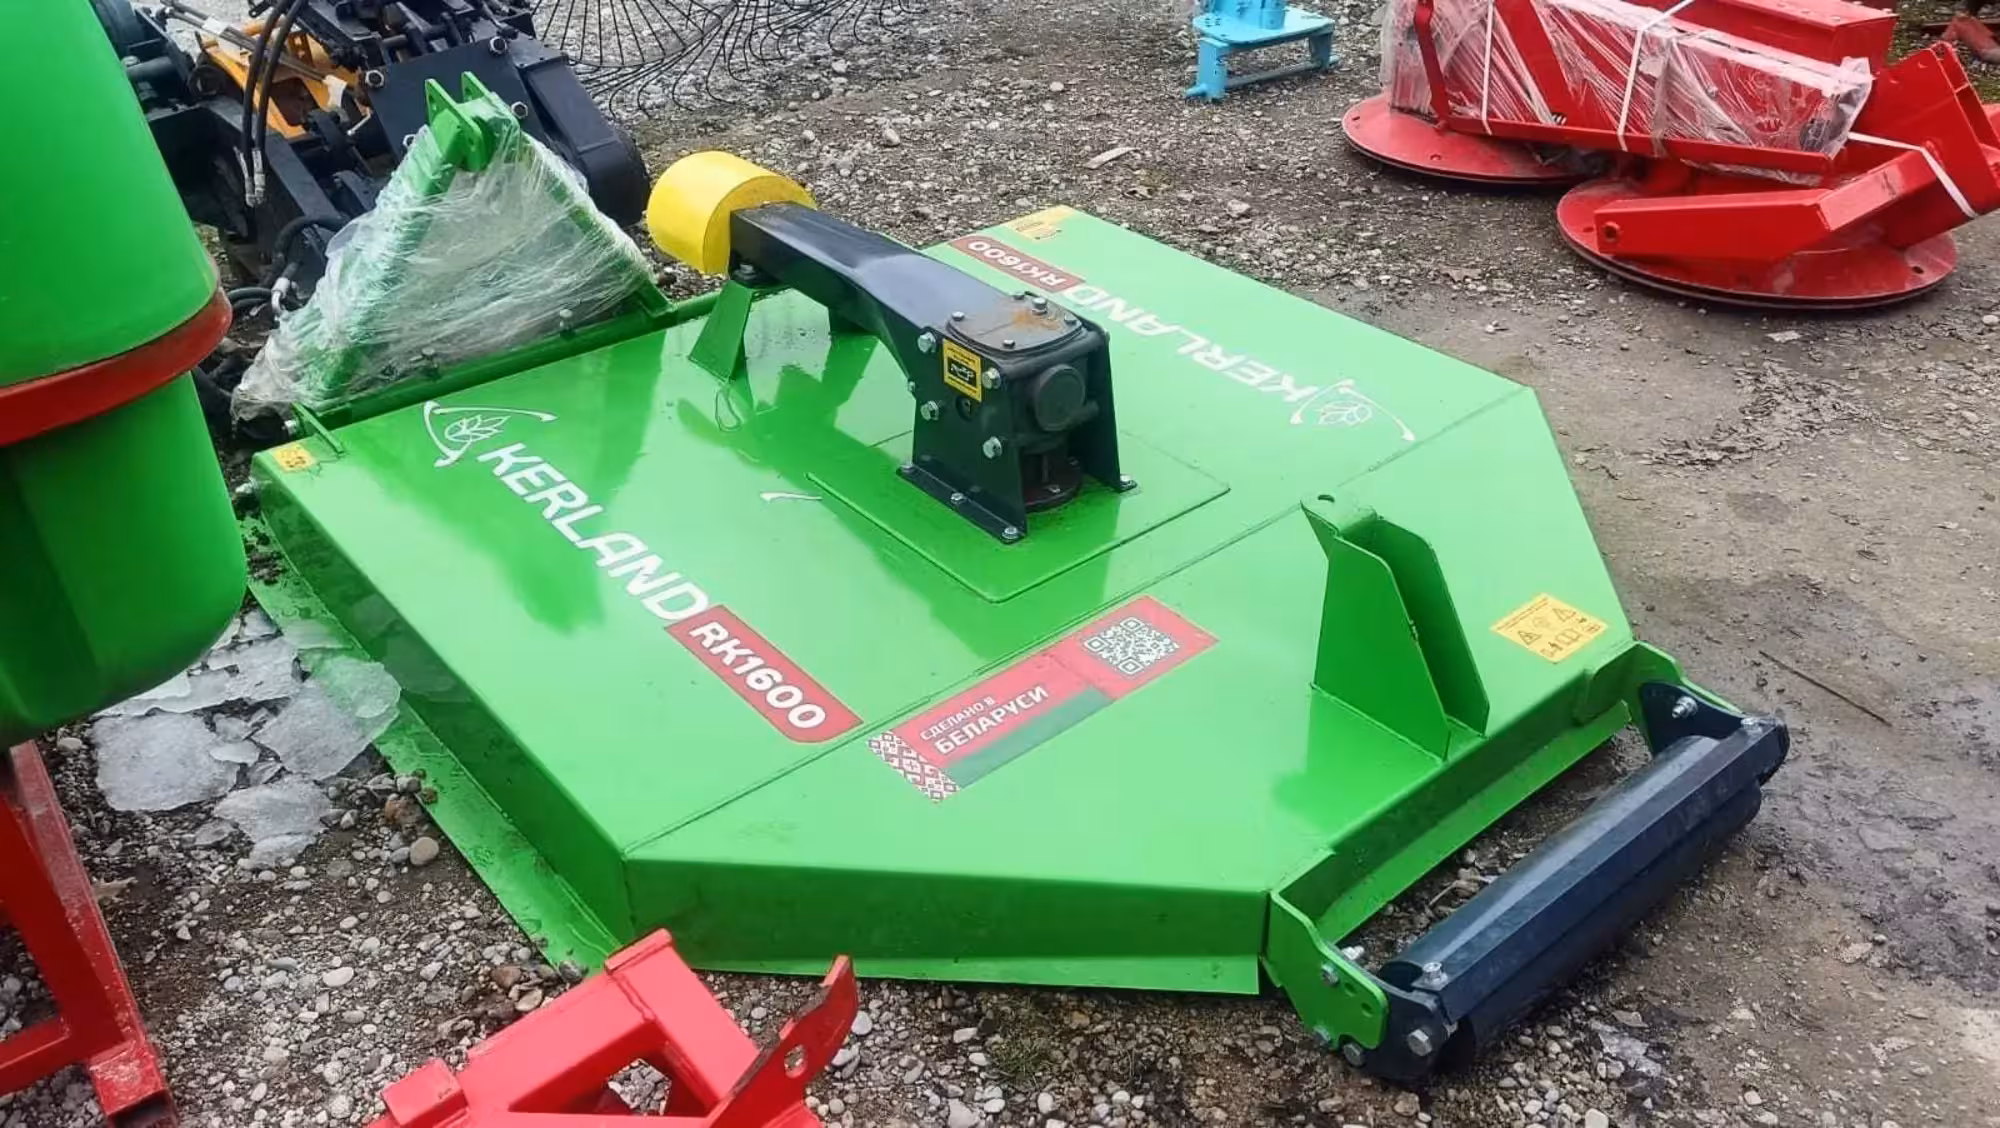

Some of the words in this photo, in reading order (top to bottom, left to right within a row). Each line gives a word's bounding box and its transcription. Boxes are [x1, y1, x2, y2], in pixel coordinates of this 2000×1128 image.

[967, 242, 1065, 286] RK1600
[1063, 287, 1318, 402] KERLAND
[477, 443, 710, 620] KERLAND
[691, 621, 826, 728] RK1600
[920, 704, 982, 740] СДЕЛАНО
[936, 686, 1048, 755] БЕЛАРУСИ
